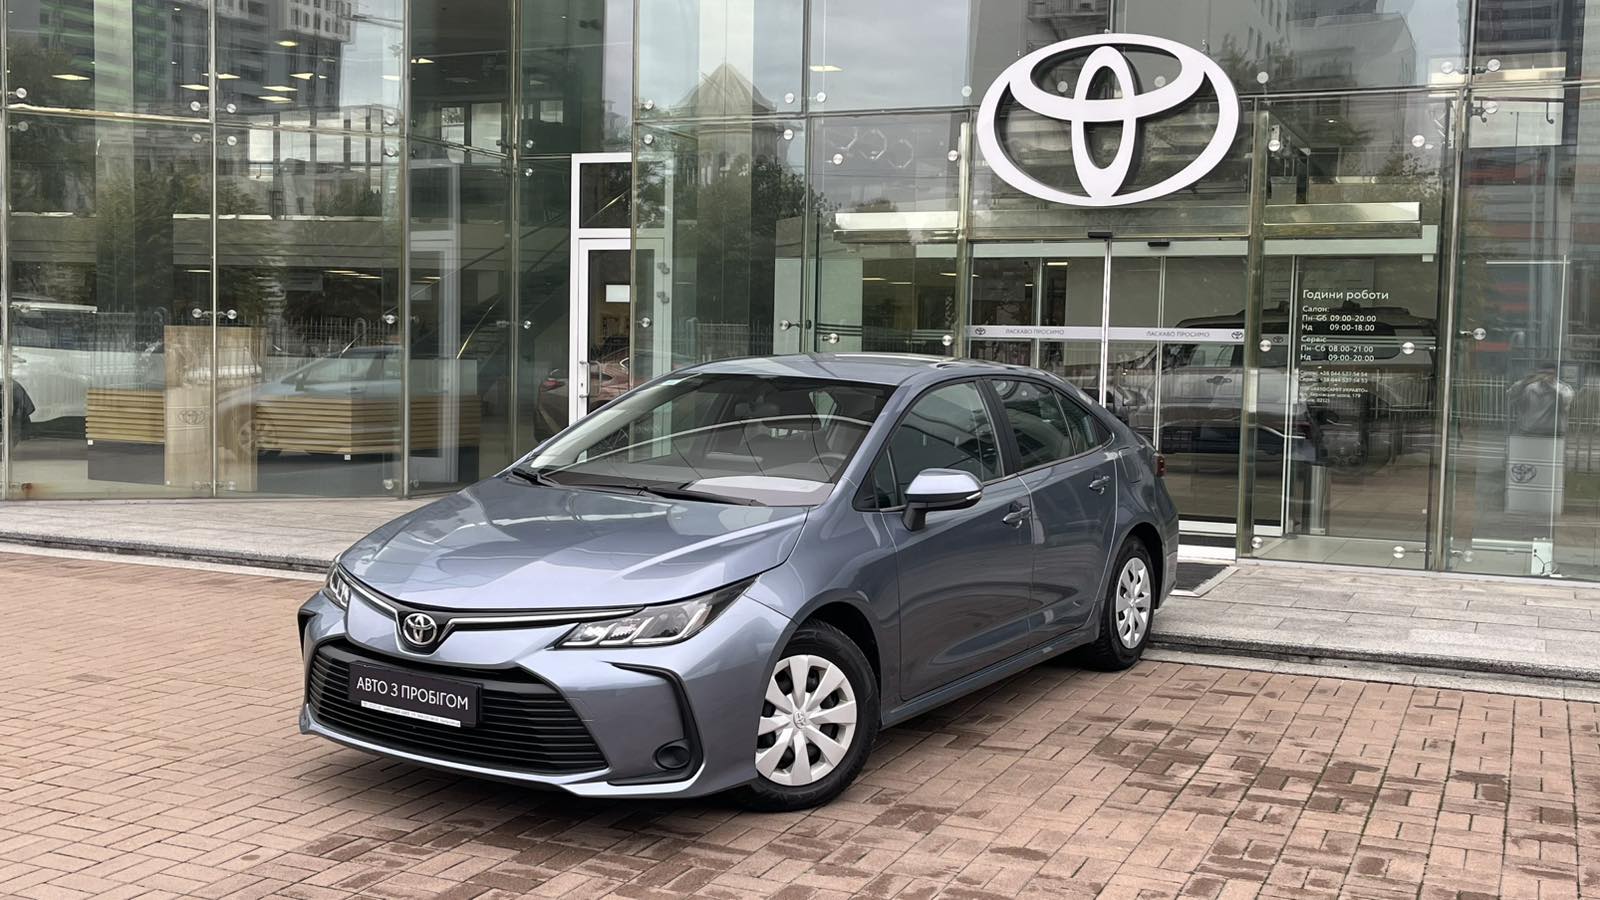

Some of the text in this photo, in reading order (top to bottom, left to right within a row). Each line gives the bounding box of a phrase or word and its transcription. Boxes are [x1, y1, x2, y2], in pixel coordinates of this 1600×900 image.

[1303, 289, 1389, 301] Години роботи
[356, 676, 388, 695] АВТО
[401, 685, 469, 711] ПРОБІГОМ
